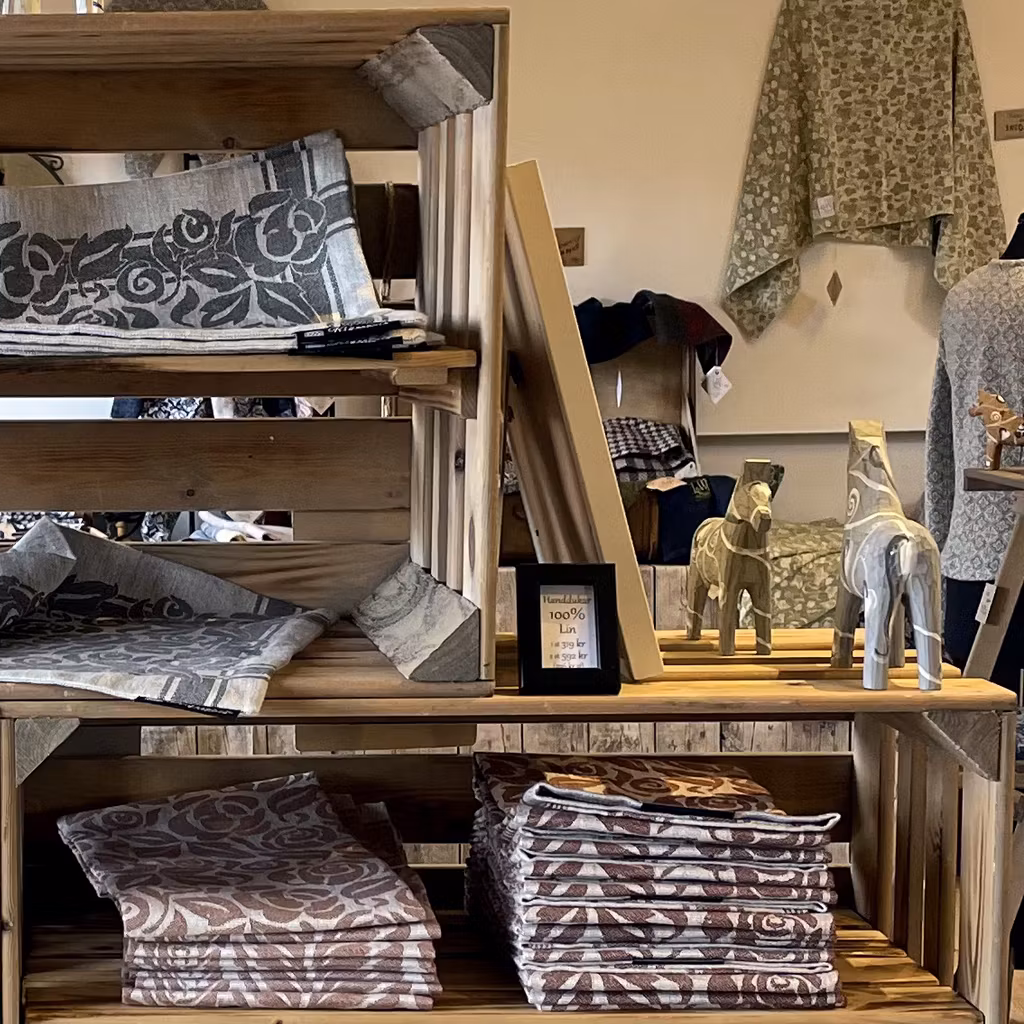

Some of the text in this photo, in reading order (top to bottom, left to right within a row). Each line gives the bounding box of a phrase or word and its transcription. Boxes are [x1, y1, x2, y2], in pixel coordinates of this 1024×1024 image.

[543, 594, 592, 604] Handdukar
[549, 607, 586, 620] 100%
[559, 623, 577, 634] Lin
[561, 641, 575, 650] 319
[576, 638, 586, 647] kr
[561, 653, 576, 662] 592
[578, 650, 588, 659] kr
